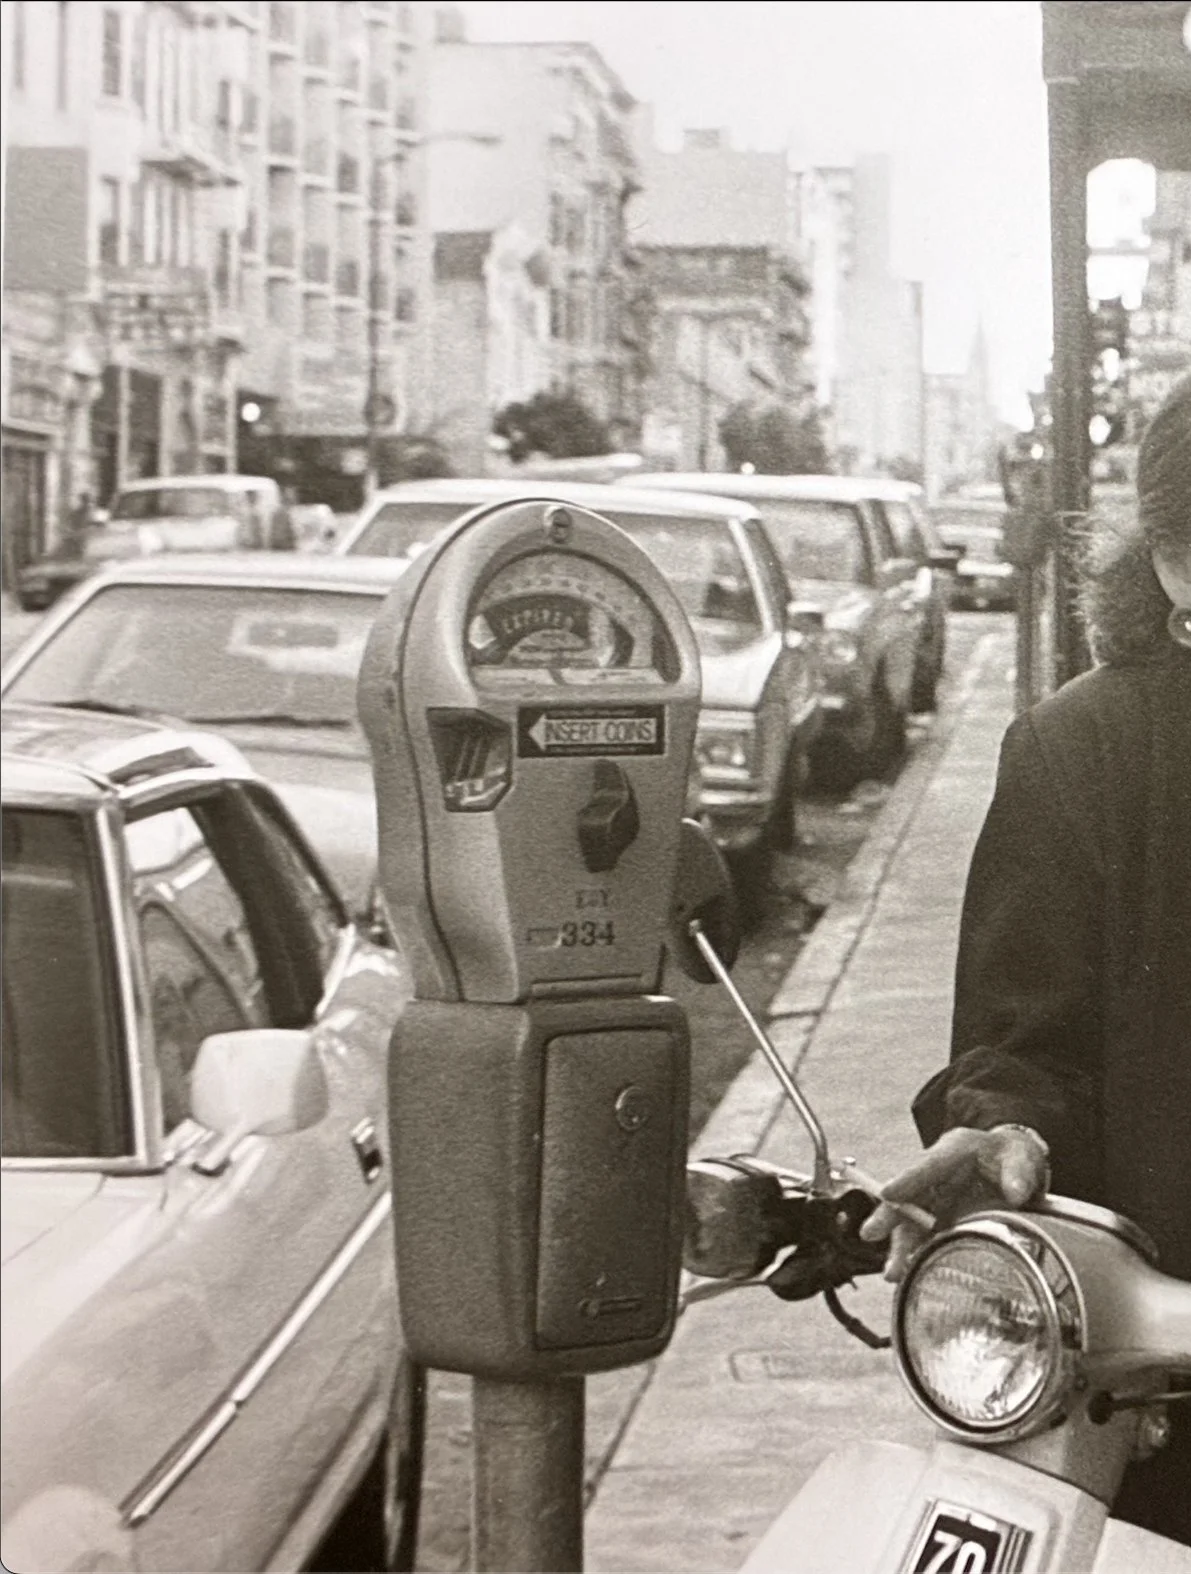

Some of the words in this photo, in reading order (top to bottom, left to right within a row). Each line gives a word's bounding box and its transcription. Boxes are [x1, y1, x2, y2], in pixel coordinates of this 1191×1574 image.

[545, 721, 600, 742] INSERT
[604, 721, 652, 741] COINS
[561, 920, 616, 947] 334
